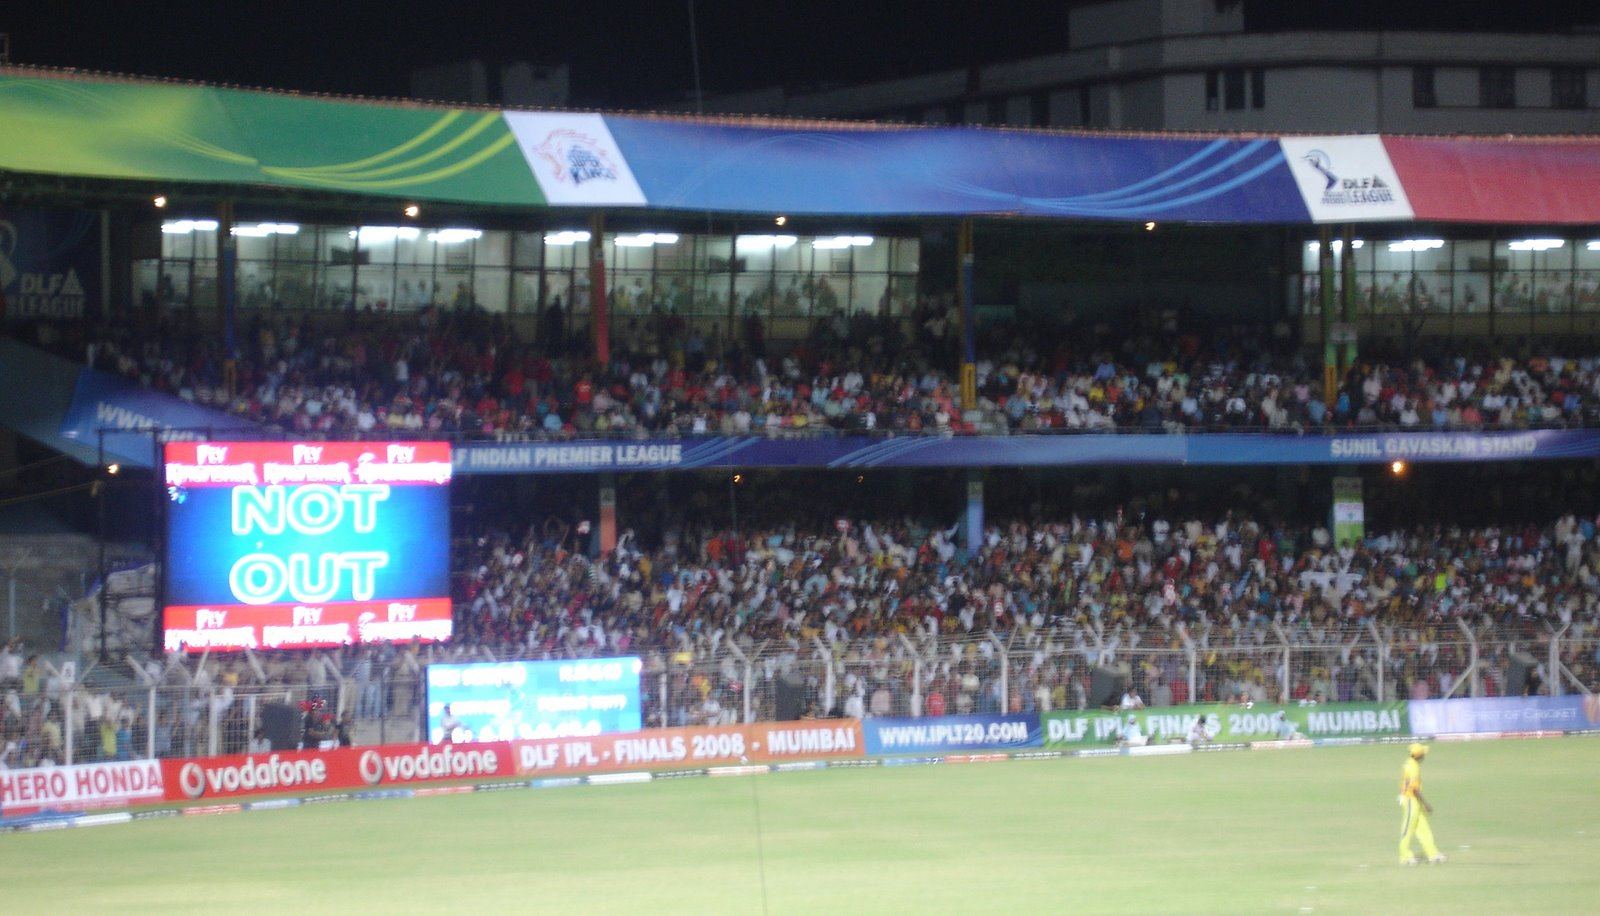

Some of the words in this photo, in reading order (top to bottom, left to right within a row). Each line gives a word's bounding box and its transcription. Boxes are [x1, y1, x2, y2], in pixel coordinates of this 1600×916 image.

[471, 447, 531, 466] INDIAN
[535, 446, 613, 465] PREMIER
[615, 445, 683, 463] LEAGUE
[1330, 438, 1382, 457] SUNIL
[1385, 437, 1477, 456] GAVASKAR
[1480, 436, 1537, 455] STAND
[231, 484, 390, 535] NOT
[229, 551, 389, 604] OUT
[878, 722, 1028, 746] WWW.IPLT20.COM
[1047, 717, 1088, 743] DLF
[1307, 709, 1401, 735] MUMBAI
[384, 745, 499, 780] vodafone
[520, 743, 559, 769] DLF
[564, 742, 598, 768] IPL
[613, 736, 687, 765] FINALS
[692, 733, 745, 759] 2008
[767, 727, 857, 755] MUMBAI
[0, 769, 67, 803] HERO
[75, 765, 163, 796] HONDA
[206, 754, 327, 793] vodafone
